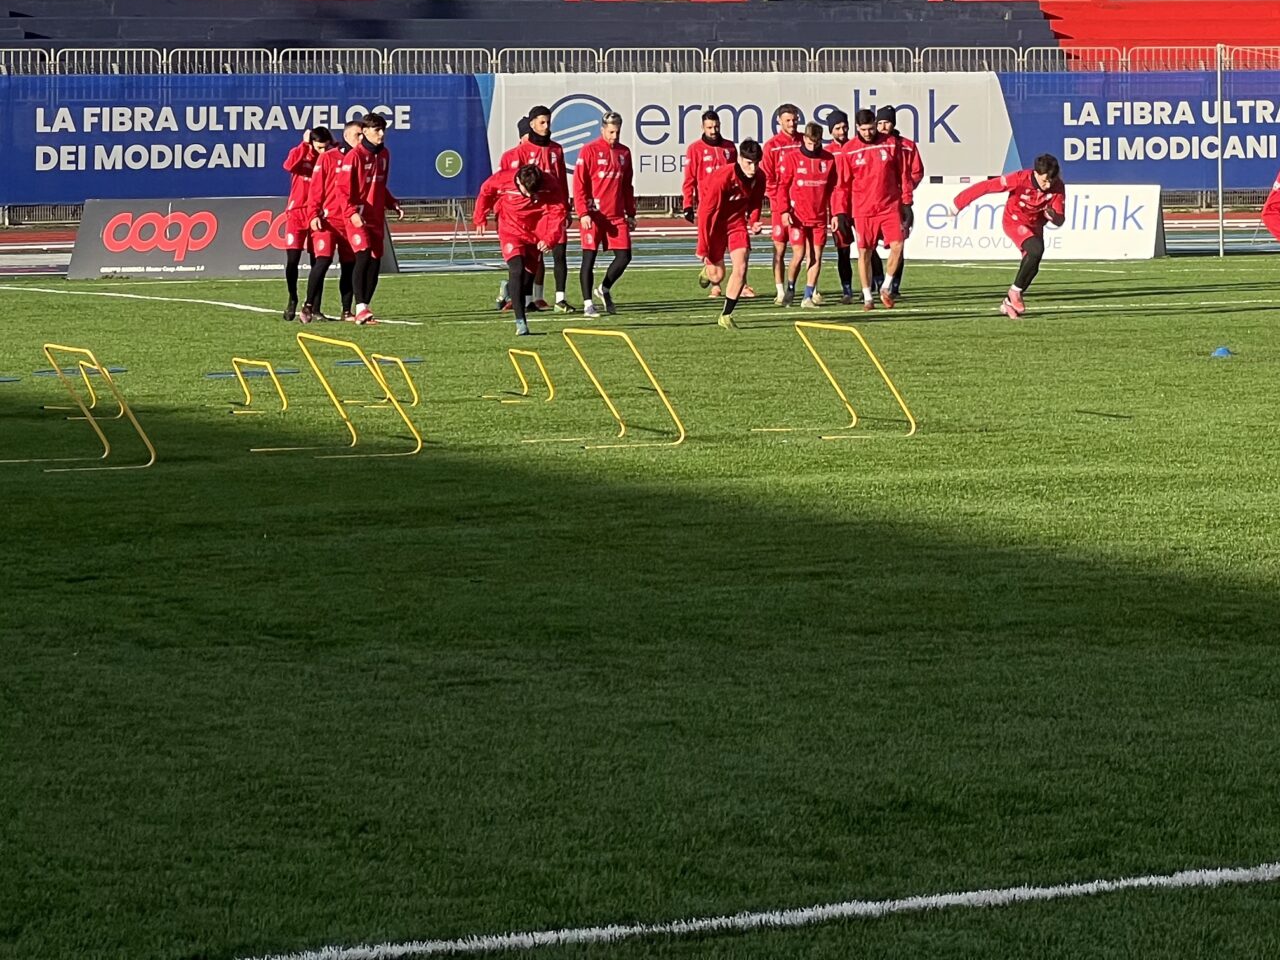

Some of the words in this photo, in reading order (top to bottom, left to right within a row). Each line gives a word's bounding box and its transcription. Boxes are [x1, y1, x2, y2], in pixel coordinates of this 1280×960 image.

[36, 107, 76, 132] LA
[83, 107, 179, 132] FIBRA
[1063, 102, 1100, 126] LA
[1106, 101, 1195, 126] FIBRA
[35, 145, 87, 171] DEI
[94, 143, 266, 170] MODICANI
[1063, 137, 1110, 161] DEI
[1117, 135, 1277, 160] MODICANI
[102, 210, 218, 262] coop
[926, 235, 974, 249] FIBRA
